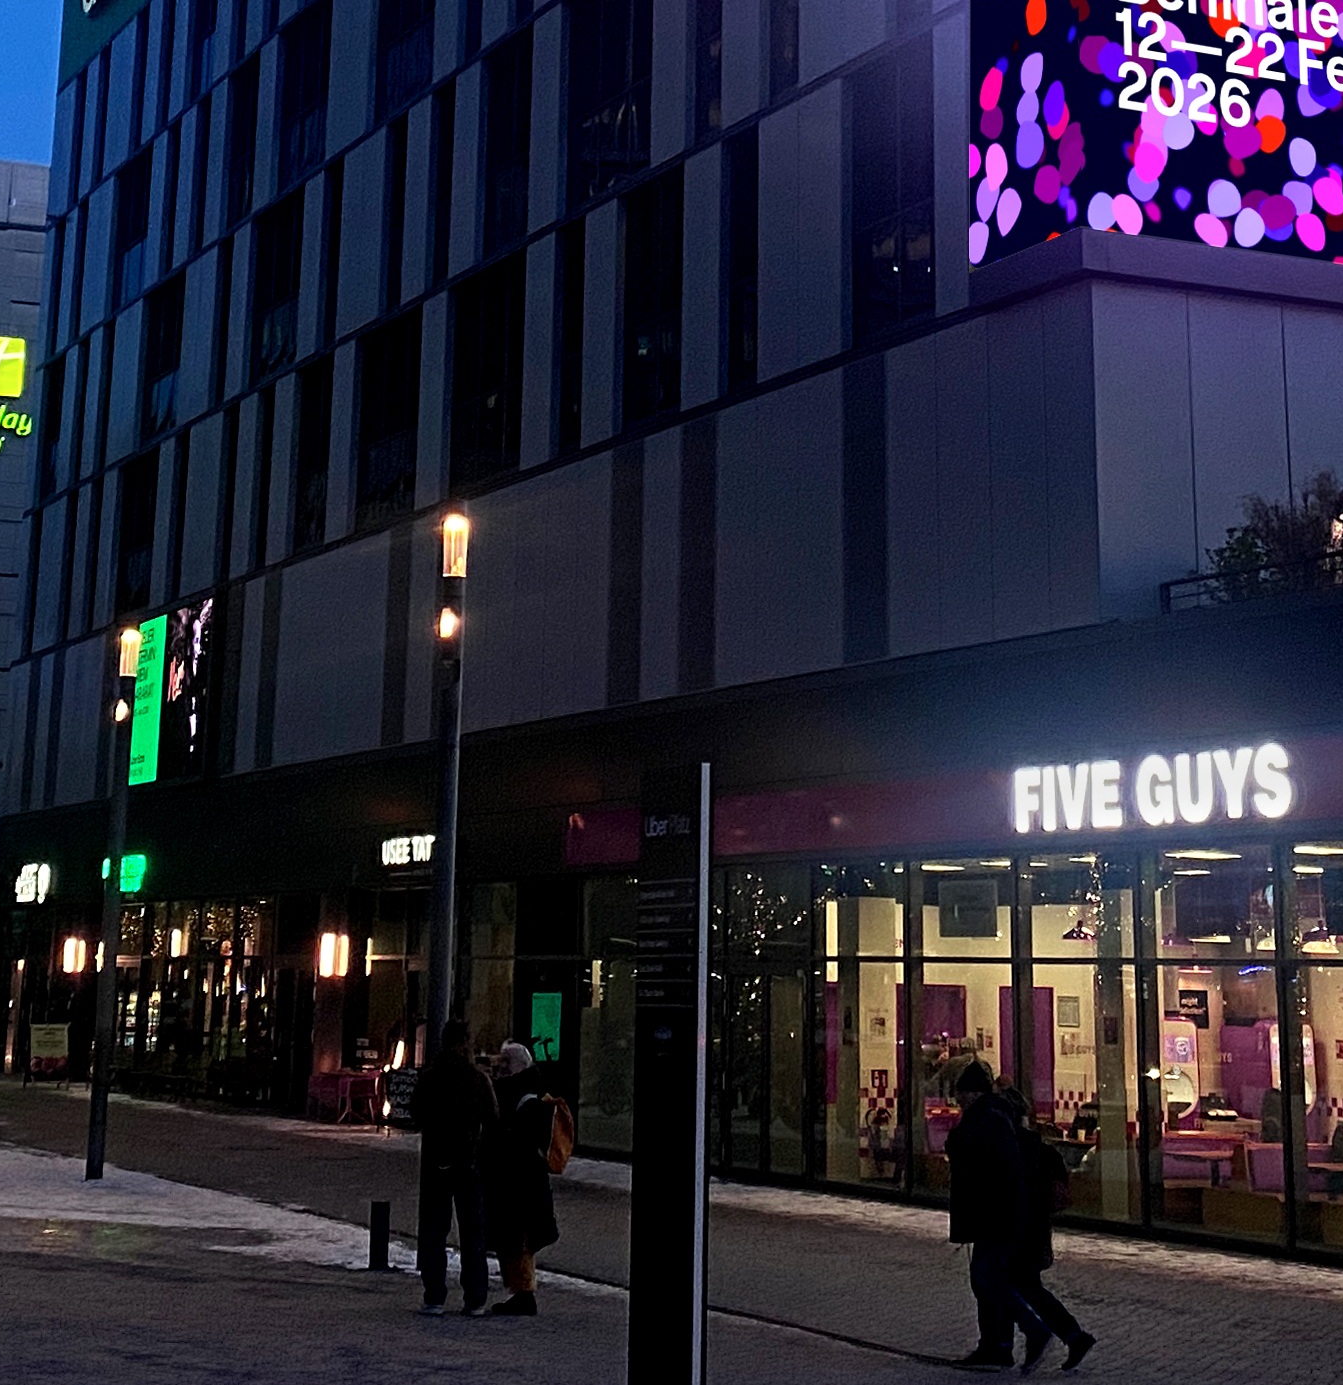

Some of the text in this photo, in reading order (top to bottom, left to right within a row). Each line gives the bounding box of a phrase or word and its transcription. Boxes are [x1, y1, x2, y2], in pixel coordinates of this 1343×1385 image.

[1117, 61, 1251, 127] 2026
[1015, 742, 1292, 833] FIVE GUYS
[644, 815, 668, 837] Uber
[382, 838, 411, 865] USEE
